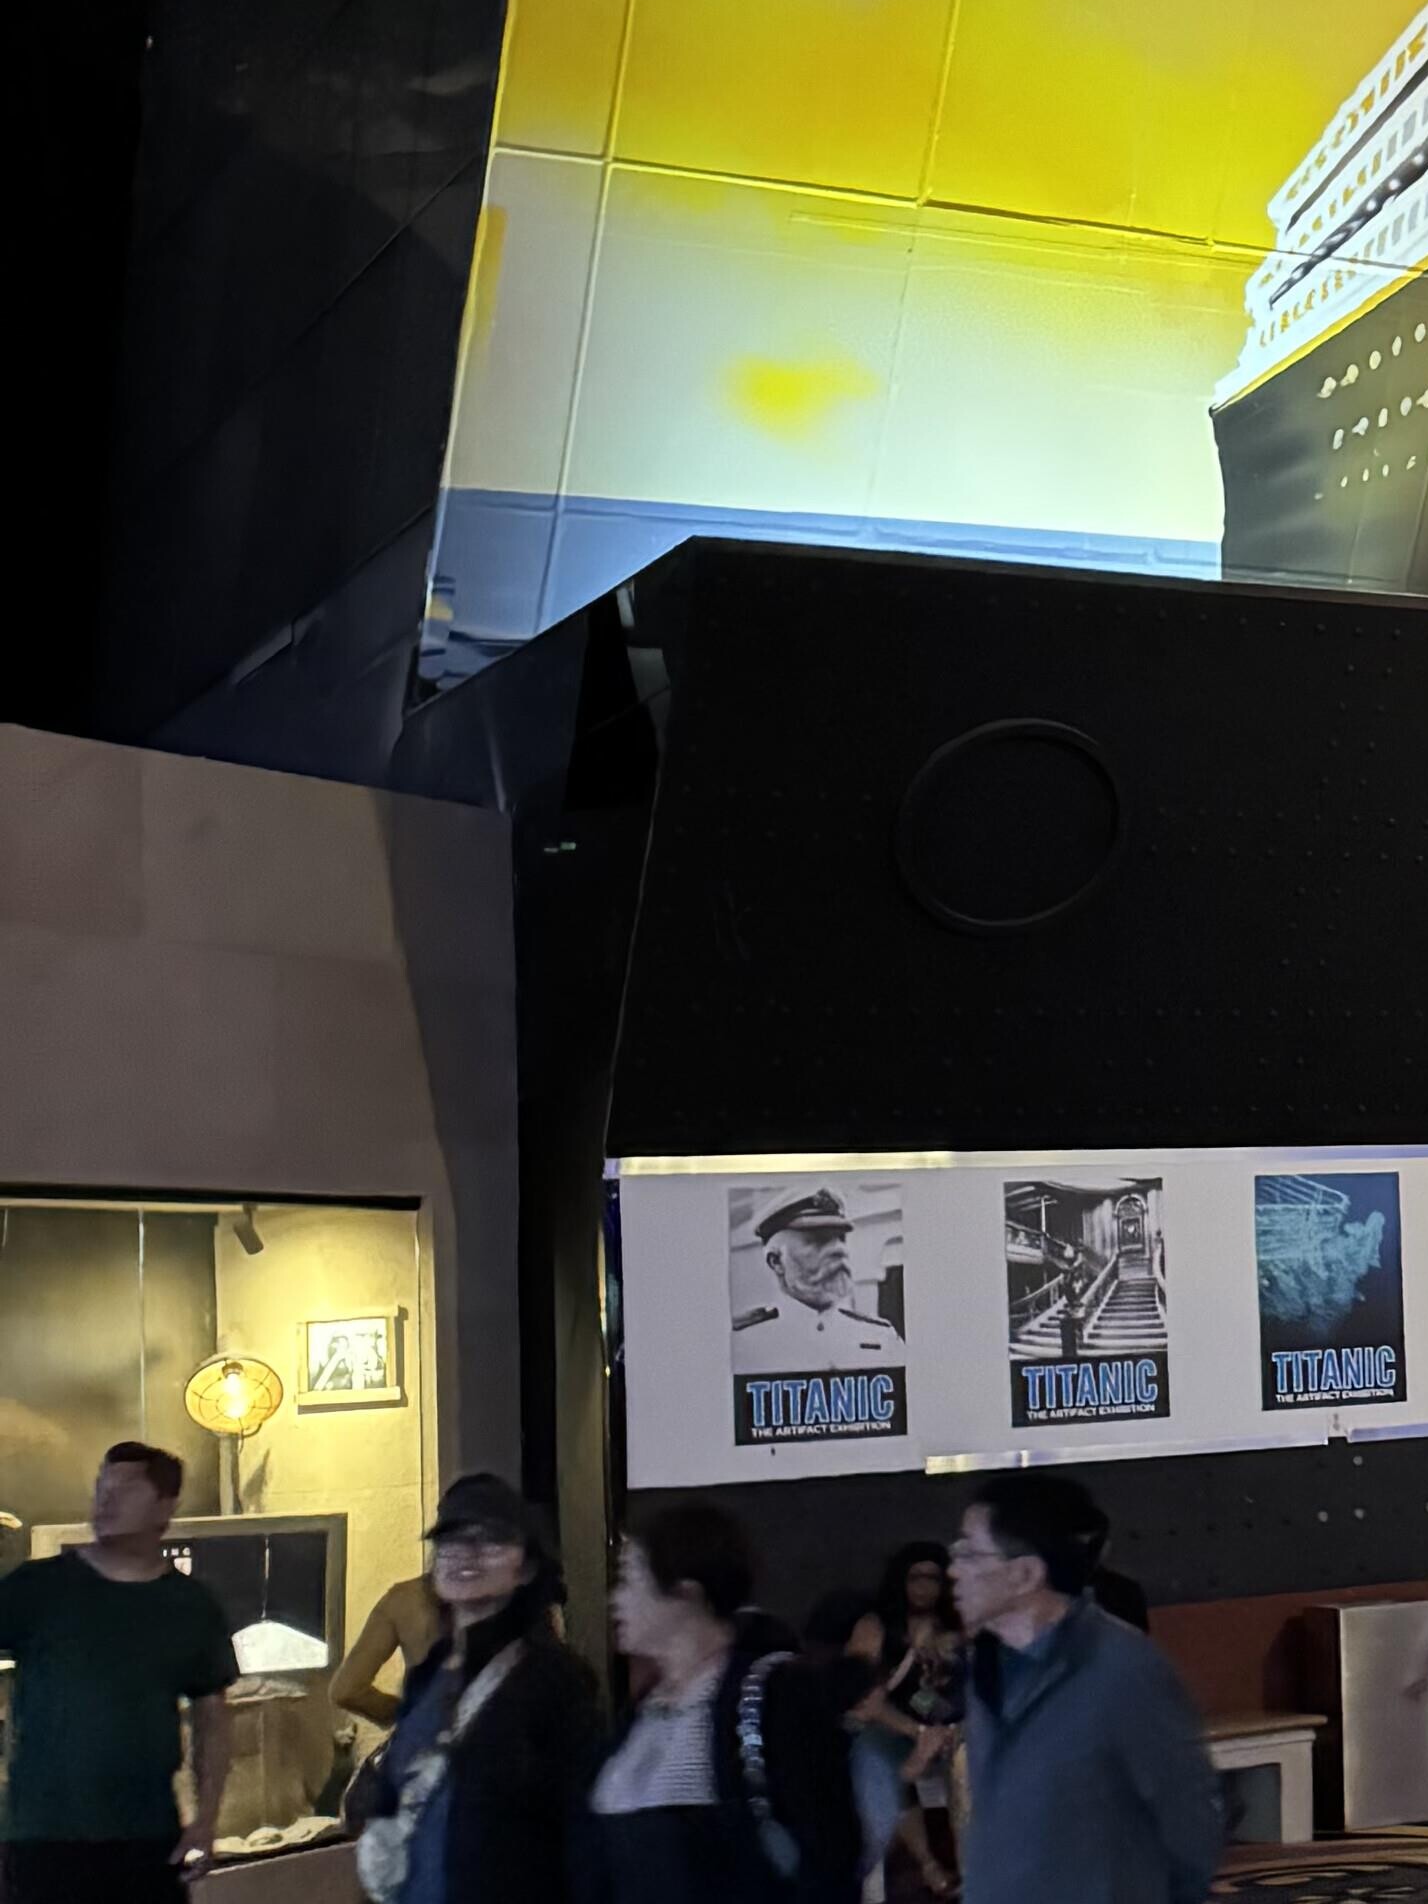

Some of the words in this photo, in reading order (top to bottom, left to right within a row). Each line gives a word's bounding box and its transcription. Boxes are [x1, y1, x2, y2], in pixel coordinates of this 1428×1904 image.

[1022, 1358, 1158, 1409] TITANIC
[1271, 1345, 1396, 1394] TITANIC
[746, 1374, 895, 1427] TITANIC
